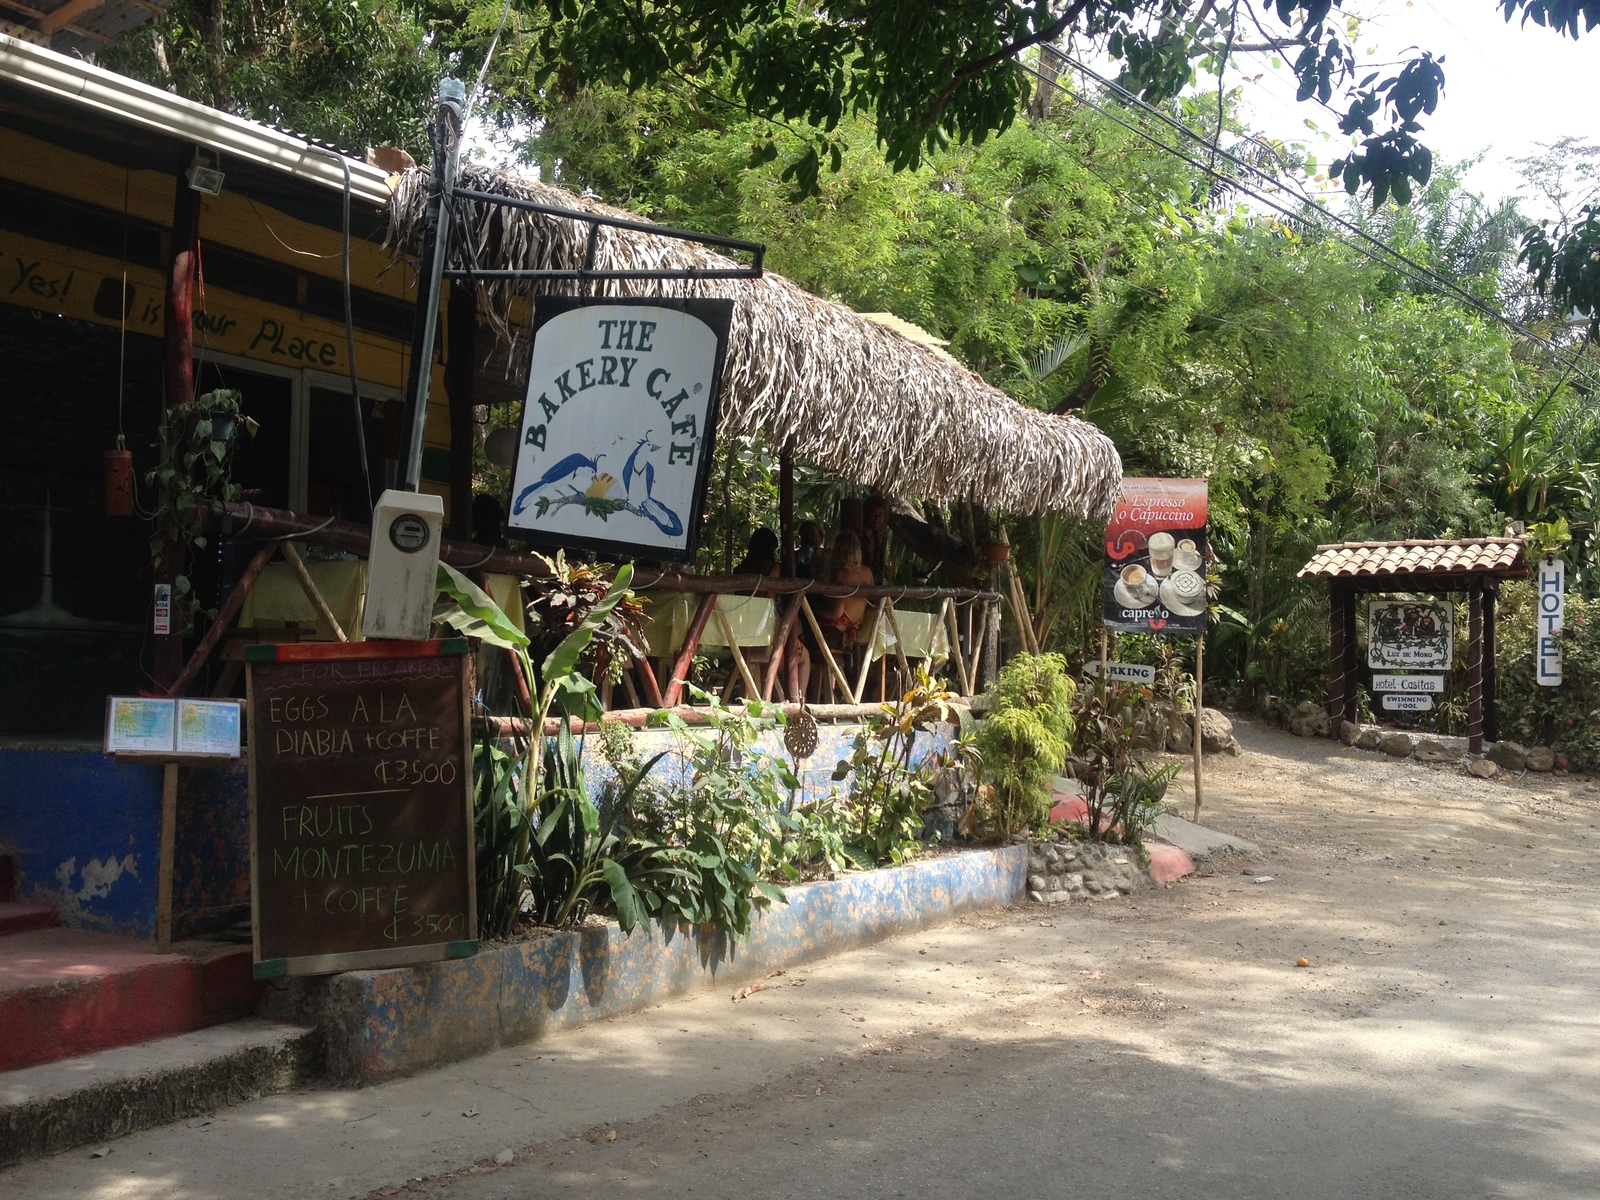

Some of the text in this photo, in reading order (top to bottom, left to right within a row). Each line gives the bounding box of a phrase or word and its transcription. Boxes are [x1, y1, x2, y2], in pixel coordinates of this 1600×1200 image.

[9, 258, 74, 303] Yes!
[141, 299, 160, 325] is
[598, 319, 657, 352] THE
[525, 356, 638, 452] BAKERY
[1119, 507, 1194, 524] o Capuccino
[1132, 495, 1186, 511] Espresso
[1541, 571, 1560, 677] HOTEL
[301, 662, 344, 680] FOR
[1401, 679, 1435, 690] Casitas
[269, 694, 329, 723] EGGS
[276, 727, 353, 756] DIABLA
[282, 804, 373, 840] FRUITS
[273, 838, 457, 880] MONTEZUMA
[325, 885, 409, 914] COFFE
